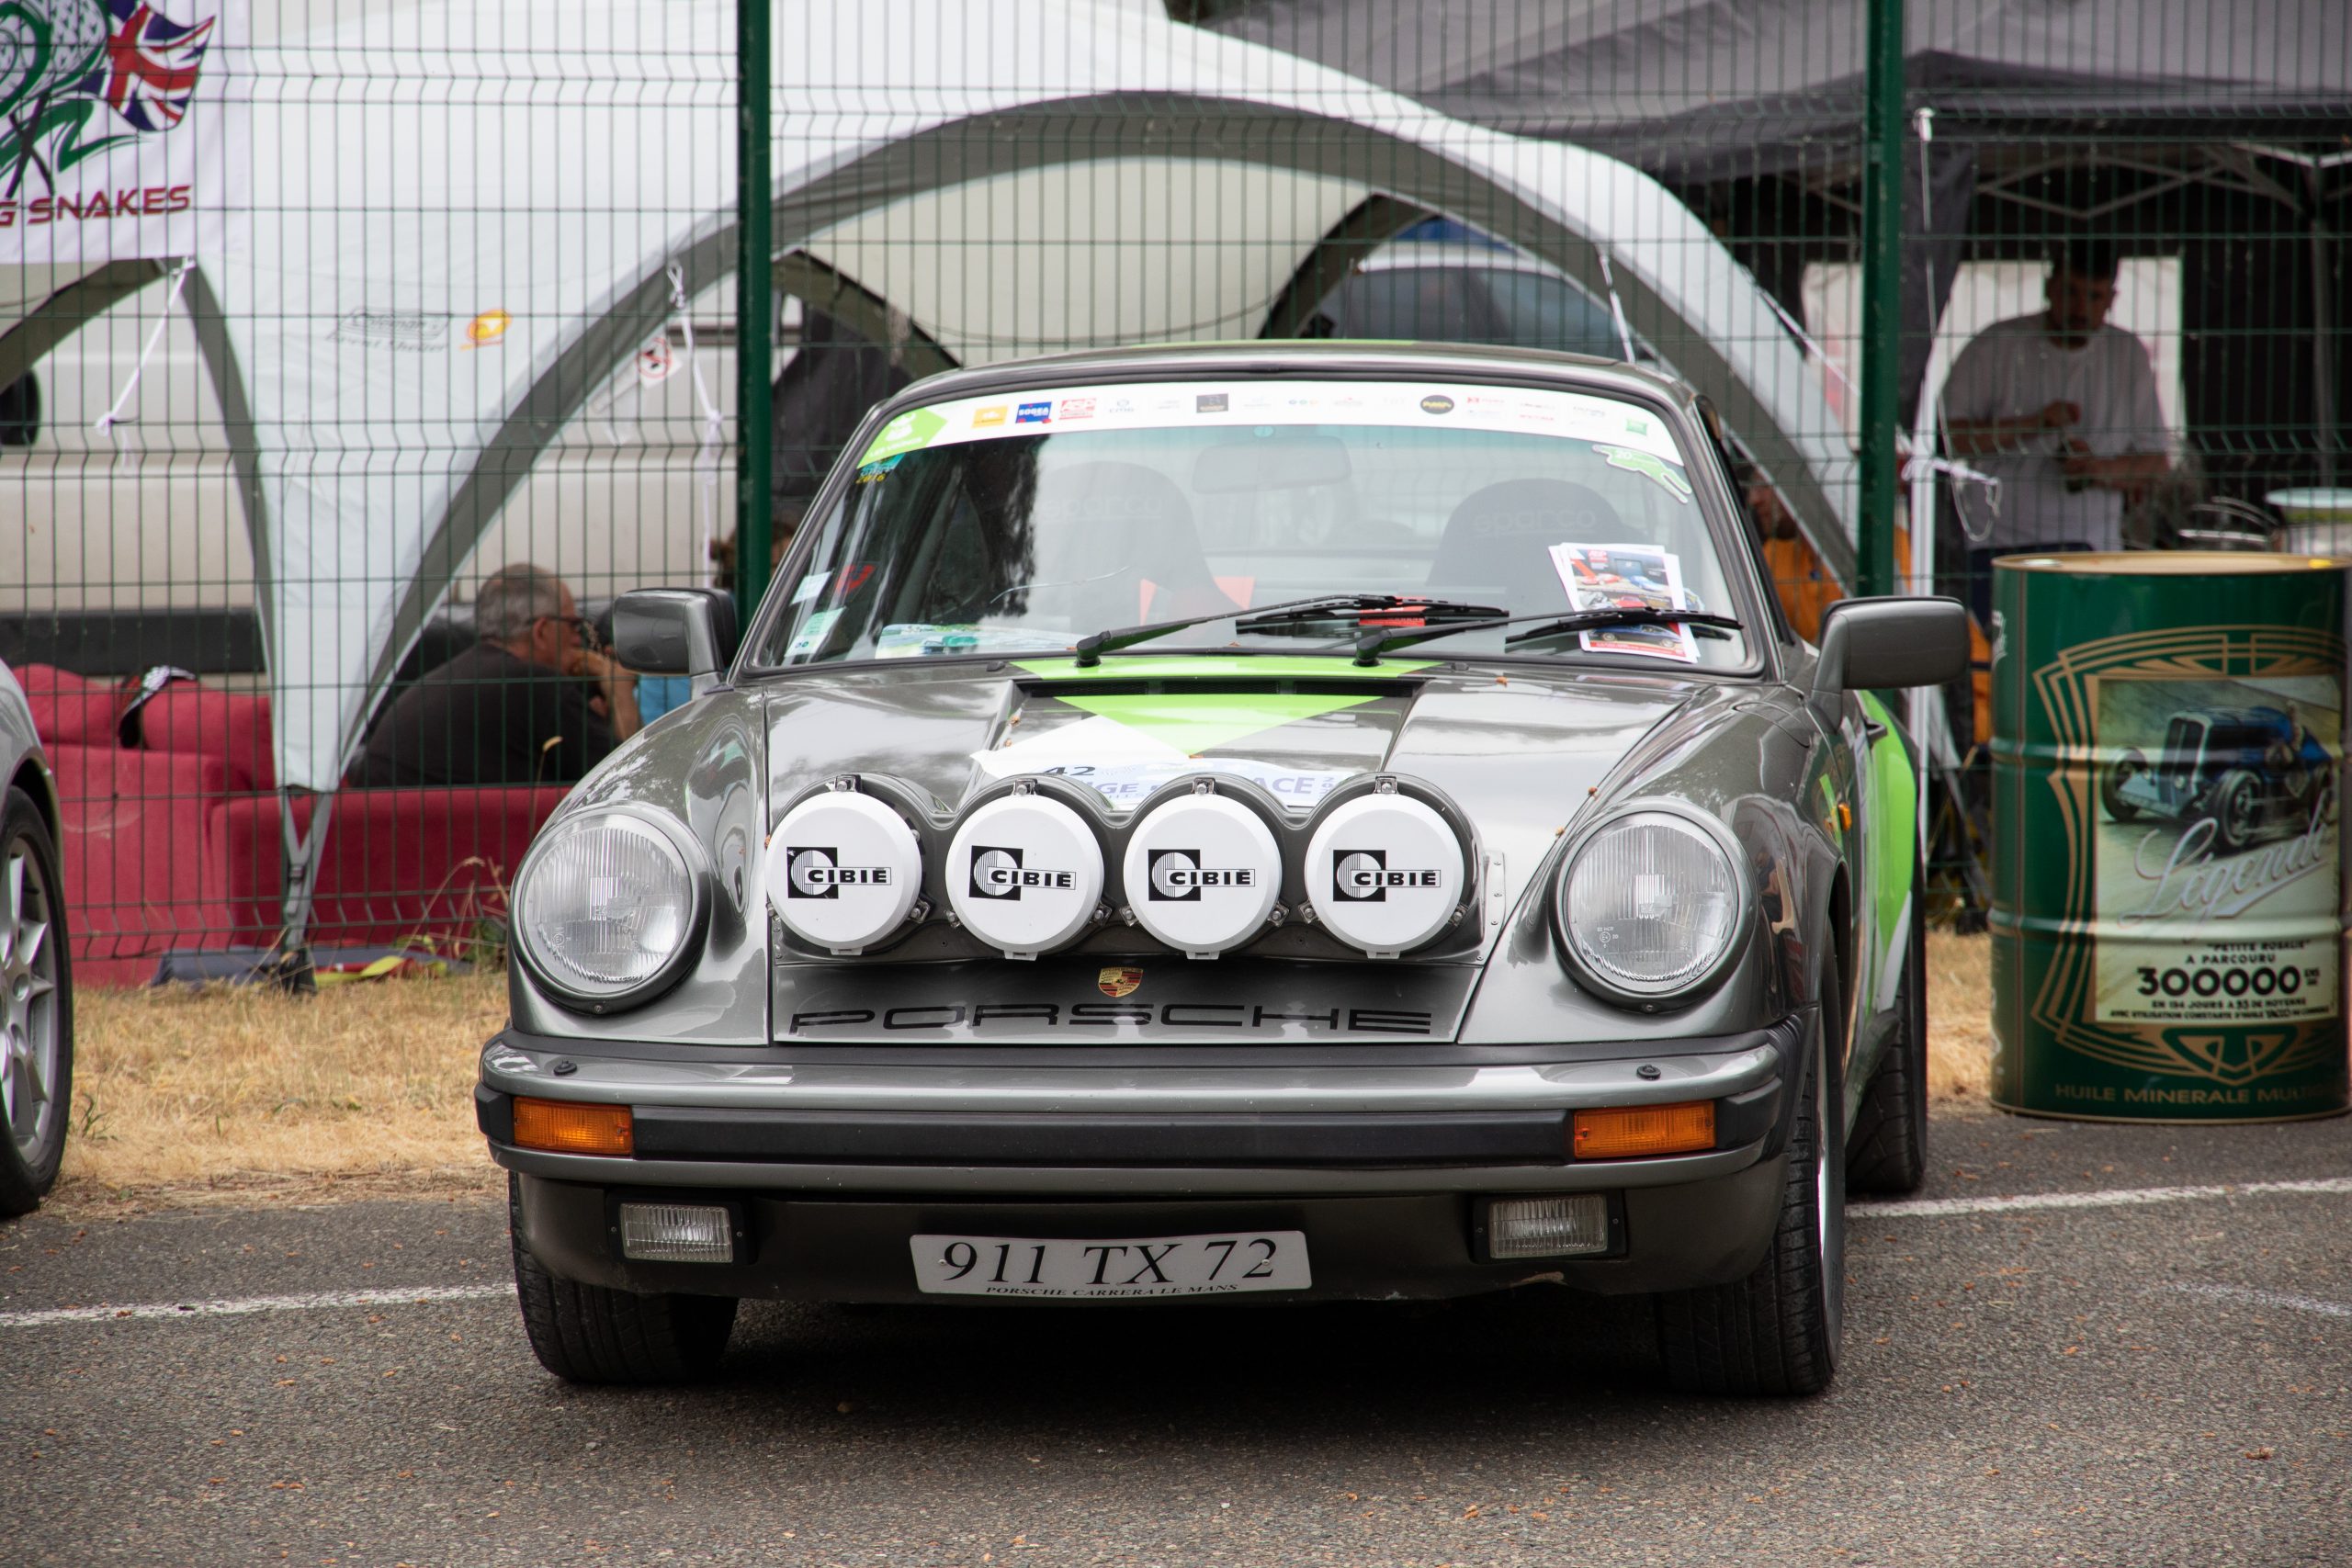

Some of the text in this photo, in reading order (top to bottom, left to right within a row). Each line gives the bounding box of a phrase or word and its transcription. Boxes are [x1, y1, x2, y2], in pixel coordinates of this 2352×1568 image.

[27, 186, 191, 226] SNAKES
[1473, 509, 1596, 539] sparco
[1044, 766, 1096, 776] 42
[2202, 954, 2277, 964] PARCOURU
[2136, 965, 2301, 997] 300000
[789, 1003, 1432, 1036] PORSCHE
[2055, 1083, 2116, 1102] HUILE
[2124, 1089, 2251, 1104] MINERALE
[943, 1238, 1278, 1285] 911 TX 72
[985, 1287, 1068, 1296] PORSCHE
[1187, 1283, 1238, 1293] MANS
